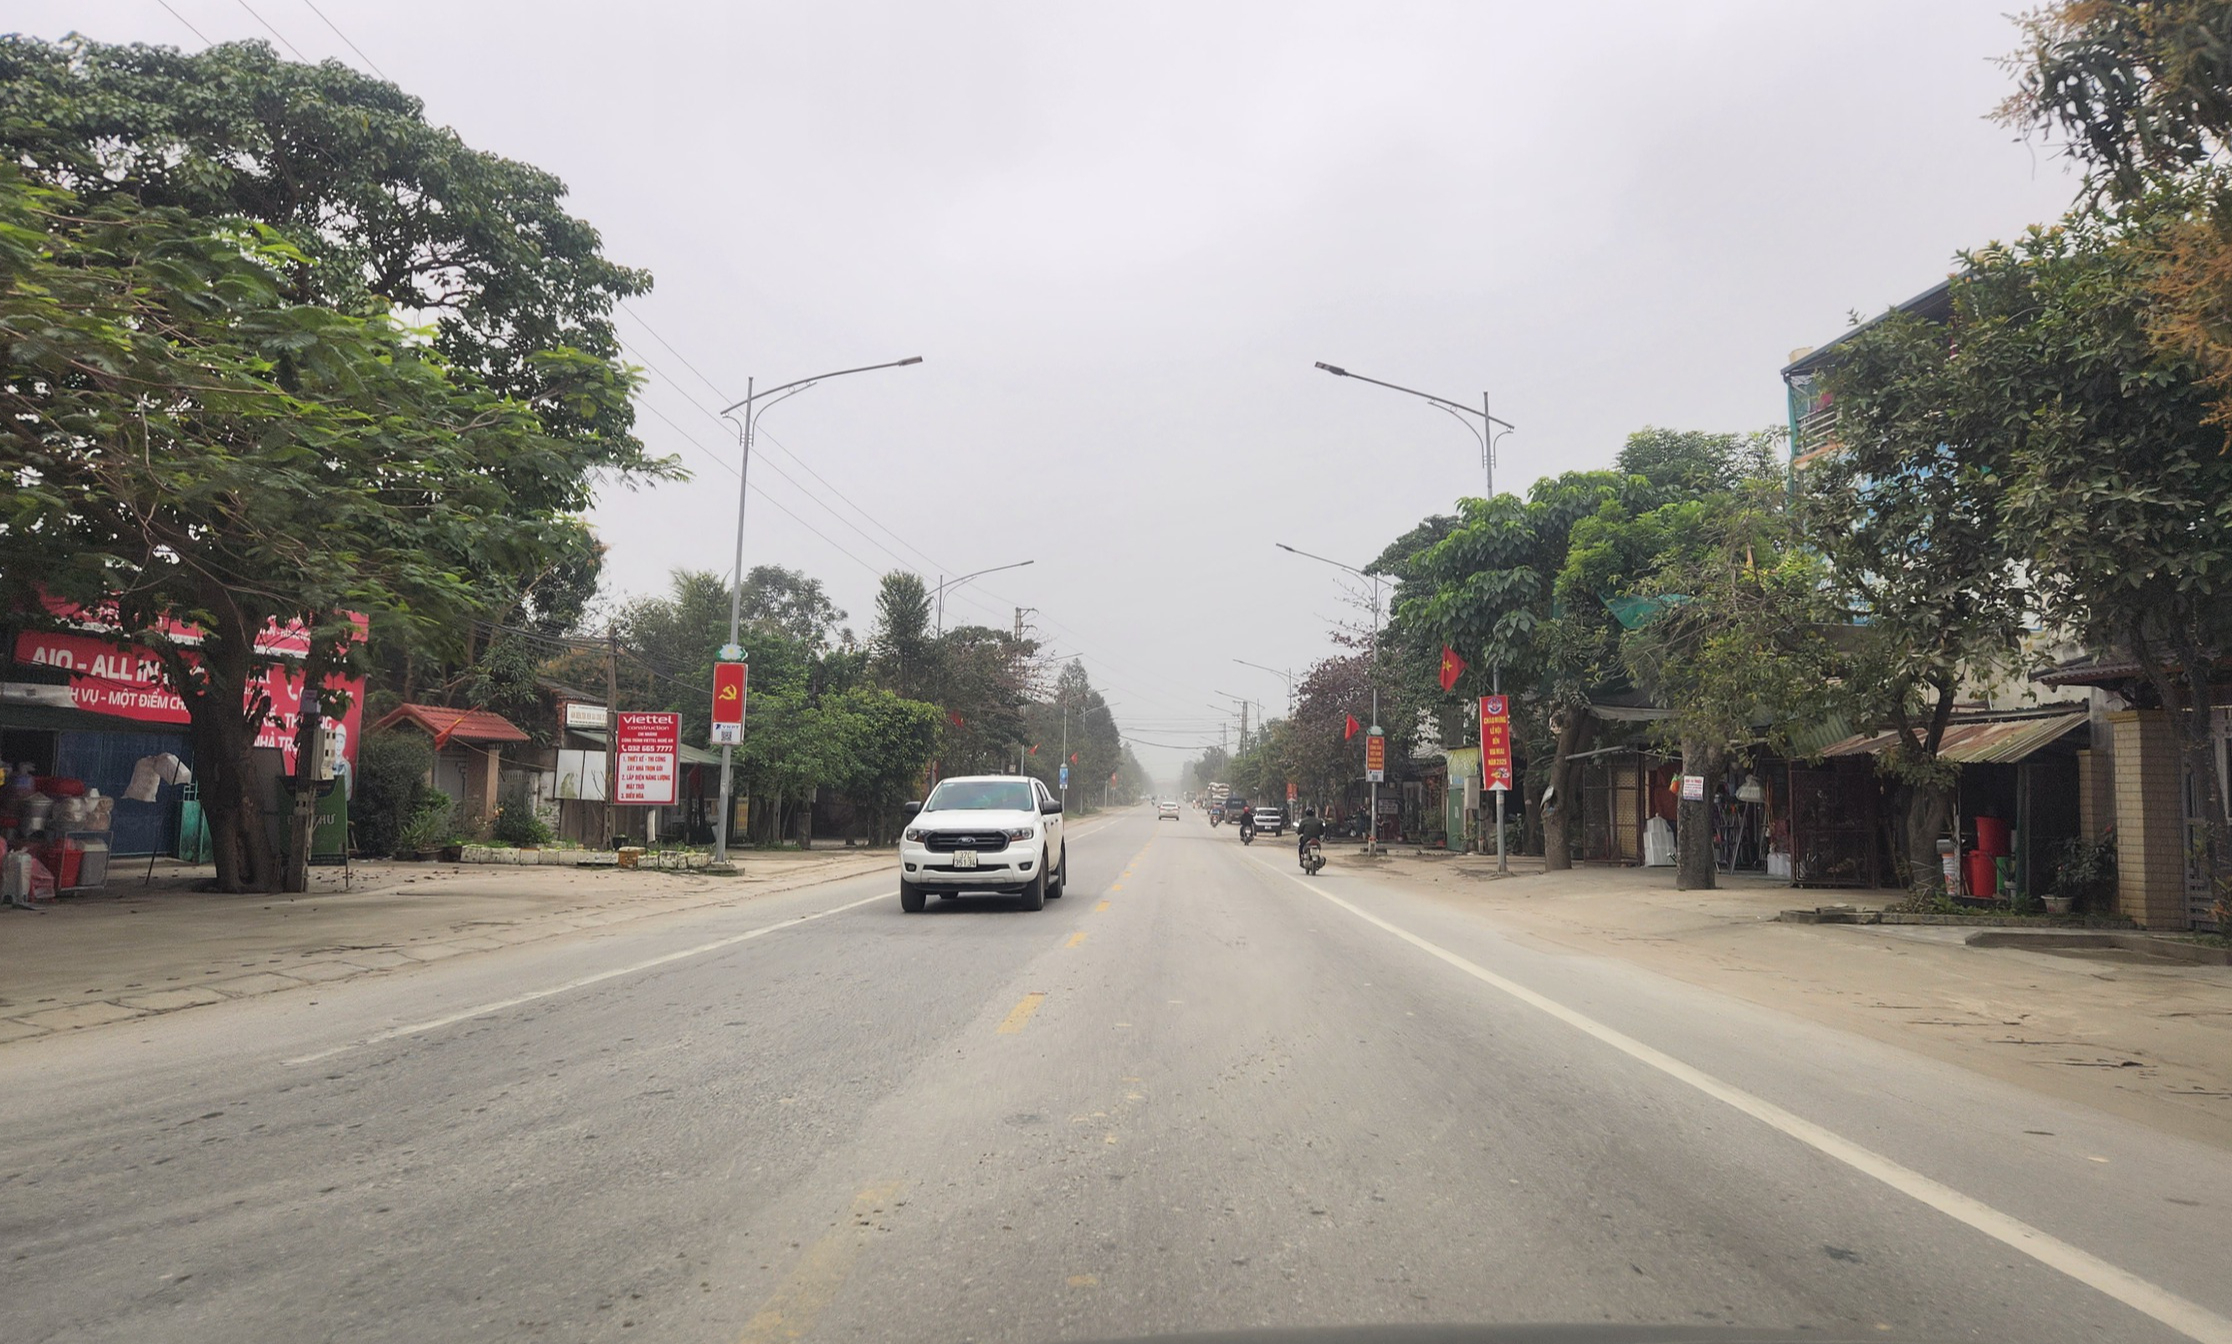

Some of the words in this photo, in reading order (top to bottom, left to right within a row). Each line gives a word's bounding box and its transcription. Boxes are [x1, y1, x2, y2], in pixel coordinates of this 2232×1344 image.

[91, 654, 133, 682] ALL
[81, 688, 99, 705] VỤ
[109, 688, 137, 708] MỘT
[622, 715, 674, 724] viettel
